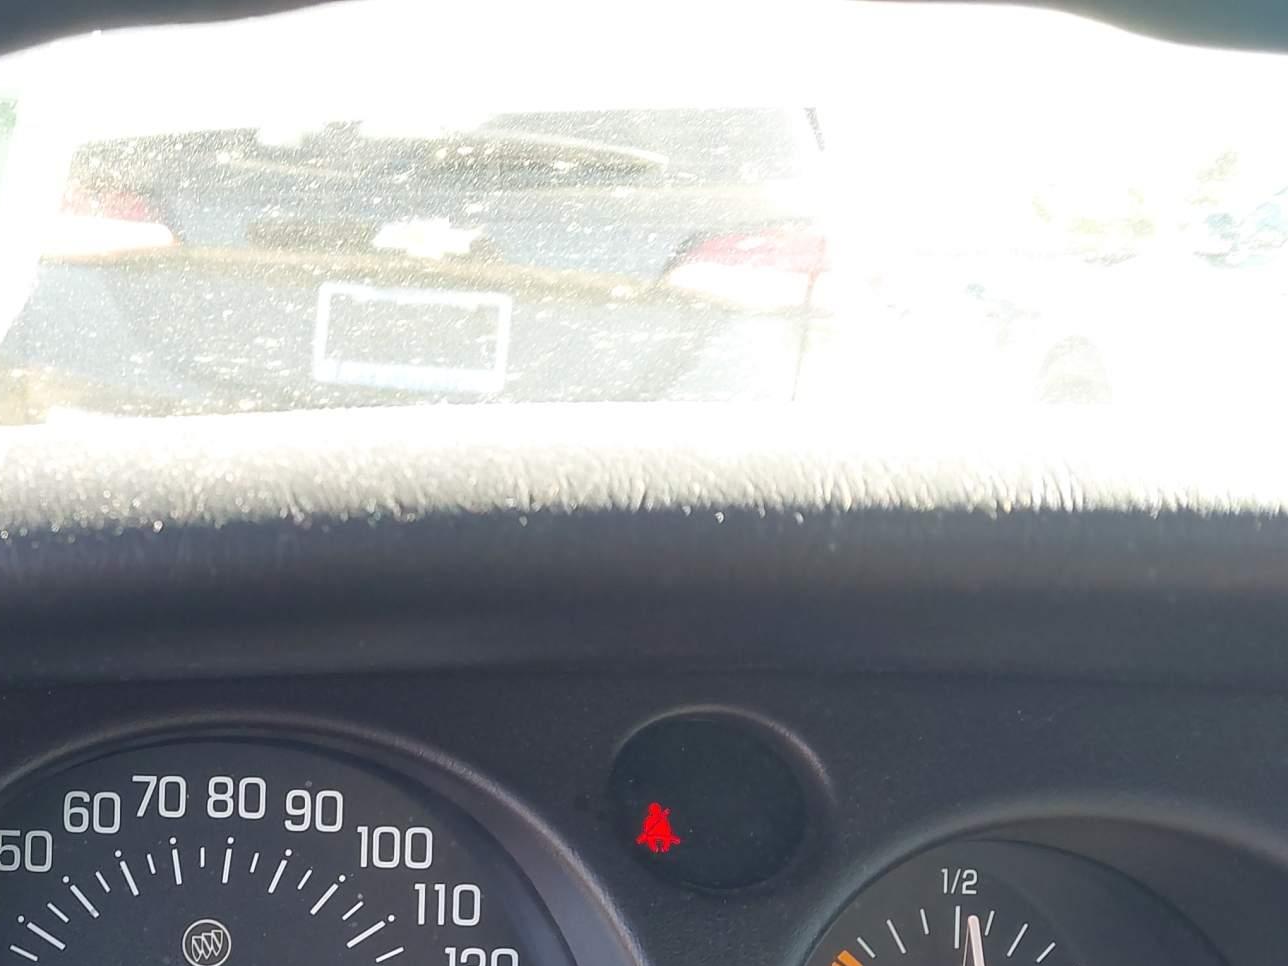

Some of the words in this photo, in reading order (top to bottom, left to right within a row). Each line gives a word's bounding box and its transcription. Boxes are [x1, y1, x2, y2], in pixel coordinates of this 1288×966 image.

[64, 791, 120, 833] 60
[133, 776, 186, 817] 70
[207, 777, 266, 819] 80
[285, 790, 343, 832] 90
[358, 827, 432, 868] 100
[942, 869, 977, 894] 1/2
[415, 884, 480, 925] 110
